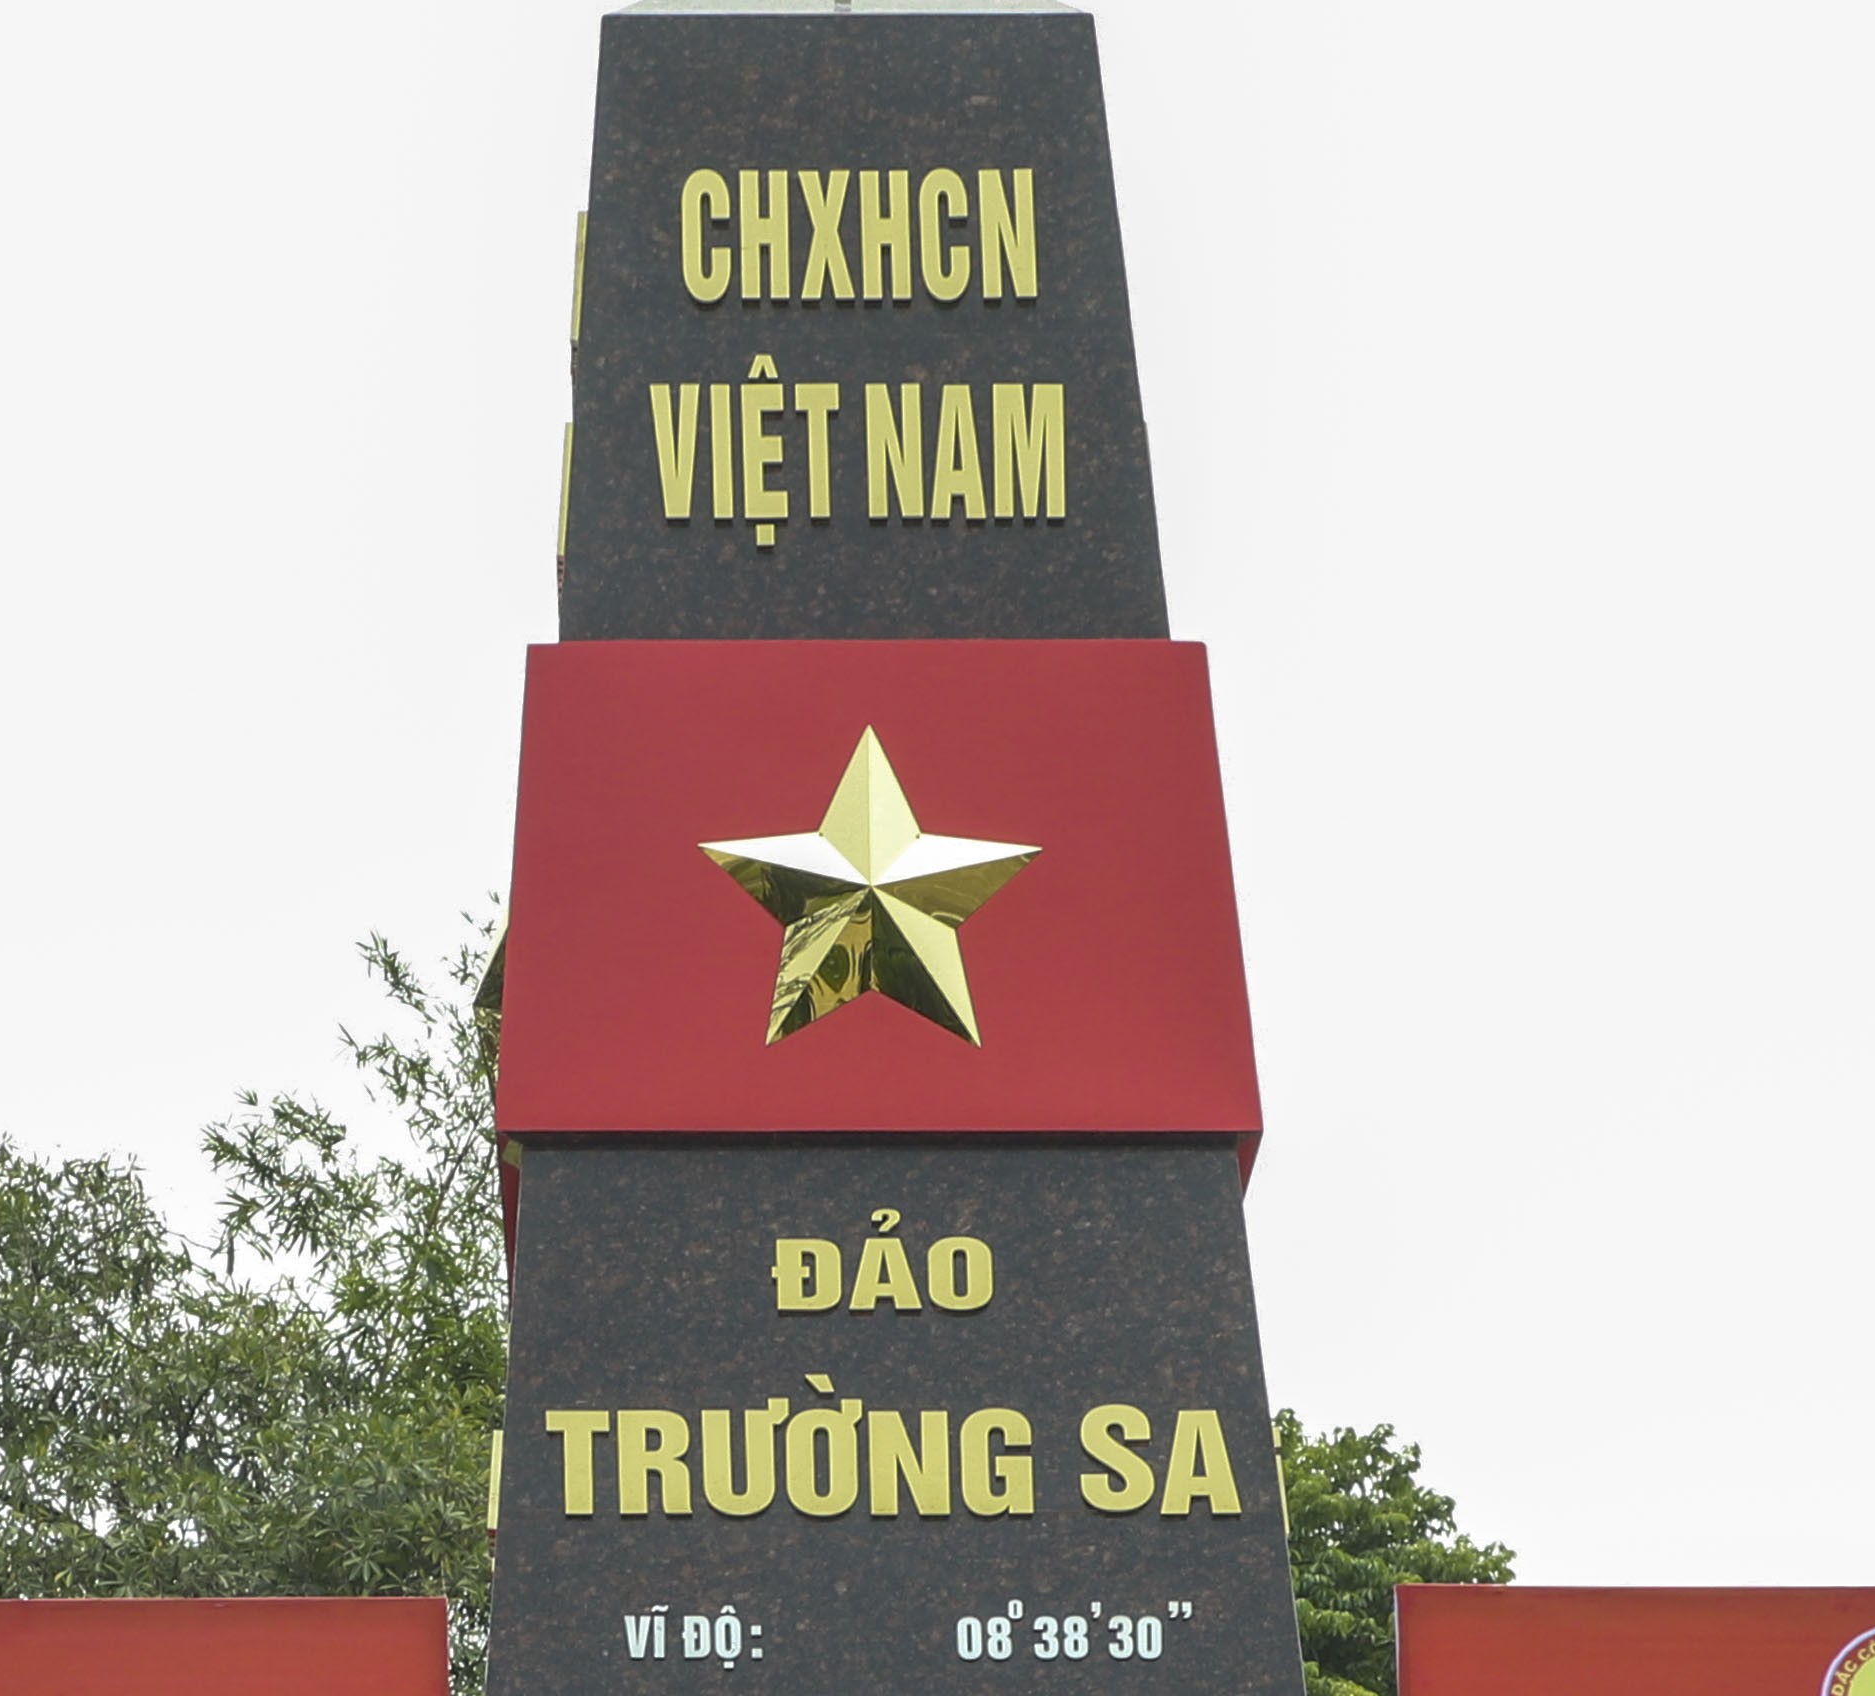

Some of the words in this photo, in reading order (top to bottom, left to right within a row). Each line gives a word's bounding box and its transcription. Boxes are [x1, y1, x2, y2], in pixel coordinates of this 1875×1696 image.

[680, 167, 1039, 303] CHXHCN
[649, 353, 840, 546] VIỆT
[864, 382, 1067, 520] NAM
[770, 1207, 995, 1312] ĐẢO
[545, 1372, 1035, 1517] TRƯỜNG
[1079, 1403, 1243, 1516] SA
[623, 1603, 668, 1660] VĨ
[680, 1603, 763, 1670] ĐỘ:
